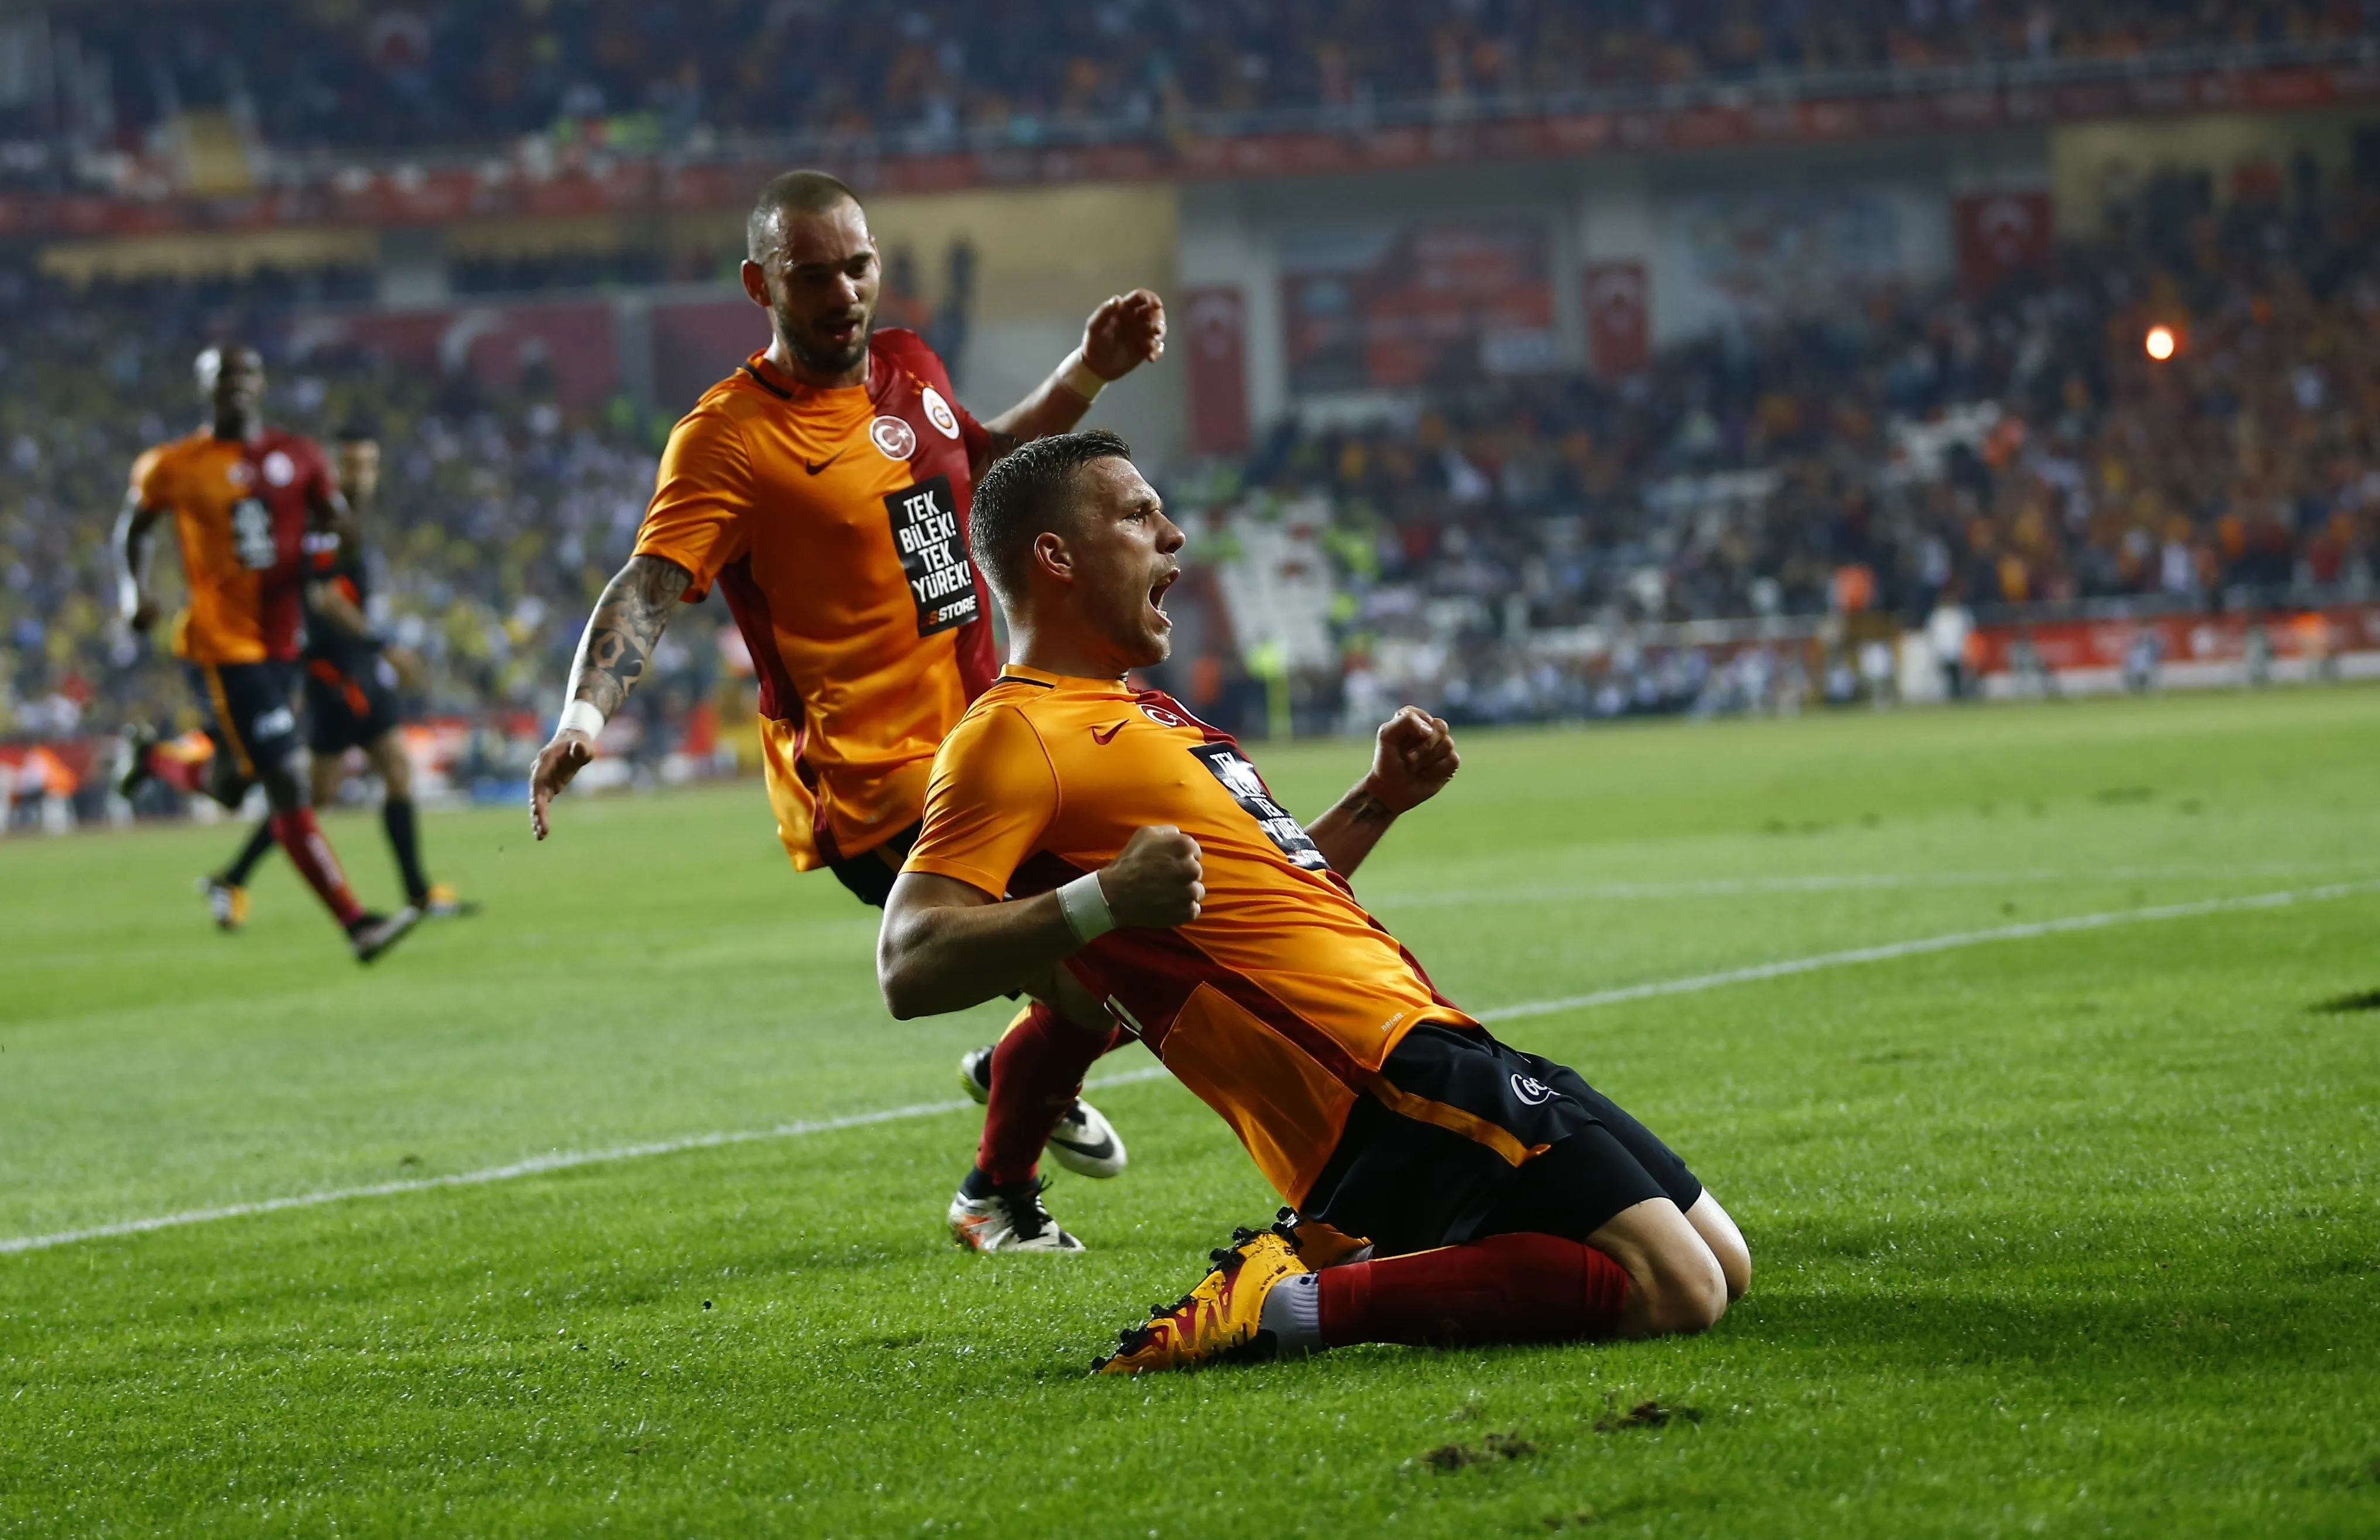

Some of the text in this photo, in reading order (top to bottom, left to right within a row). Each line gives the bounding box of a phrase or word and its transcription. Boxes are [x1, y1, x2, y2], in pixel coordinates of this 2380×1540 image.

[903, 491, 940, 524] TEK
[918, 540, 955, 572] TEK
[911, 560, 972, 603] YÜREK!
[1250, 797, 1285, 817] TEK
